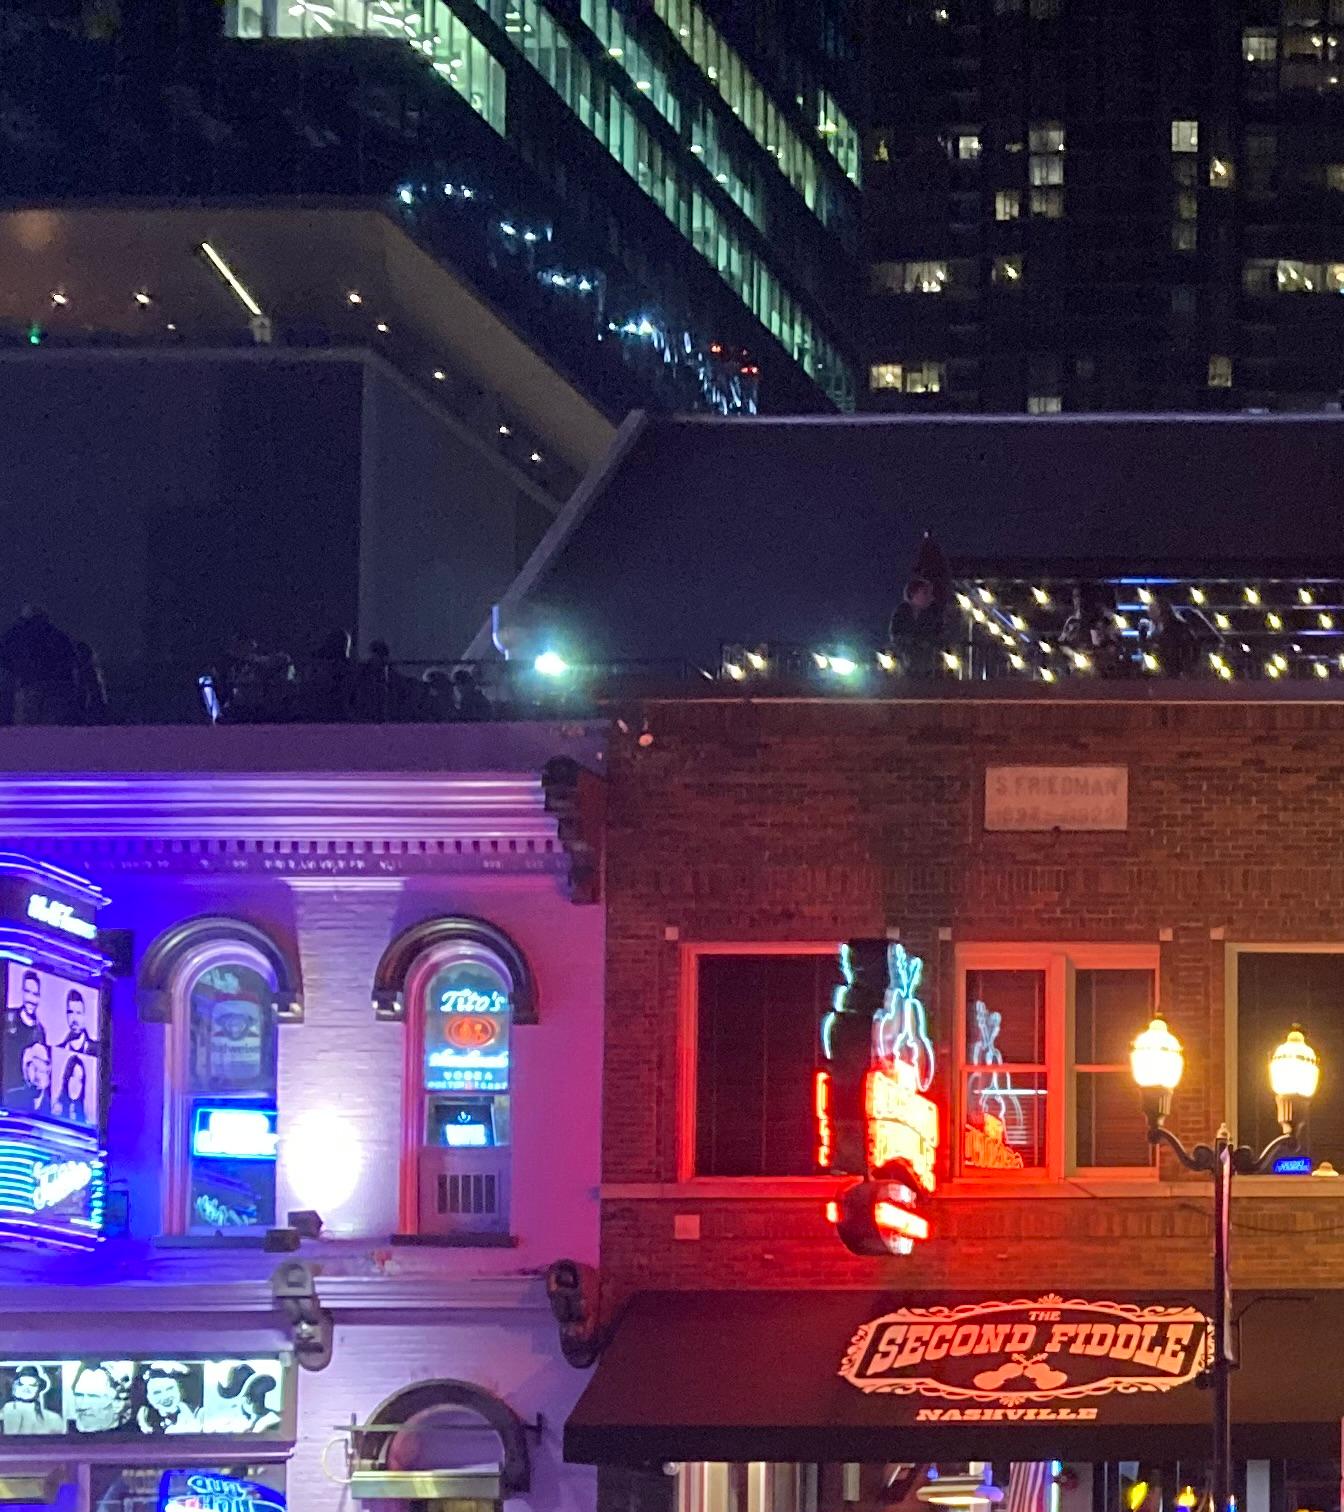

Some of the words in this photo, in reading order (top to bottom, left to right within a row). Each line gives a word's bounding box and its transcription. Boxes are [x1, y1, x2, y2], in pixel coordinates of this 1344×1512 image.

[439, 988, 506, 1013] Tito's
[1028, 1310, 1062, 1322] THE
[866, 1323, 1037, 1376] SECOND
[1044, 1323, 1195, 1375] FIDDLE
[915, 1407, 1099, 1422] NASHVILLE
